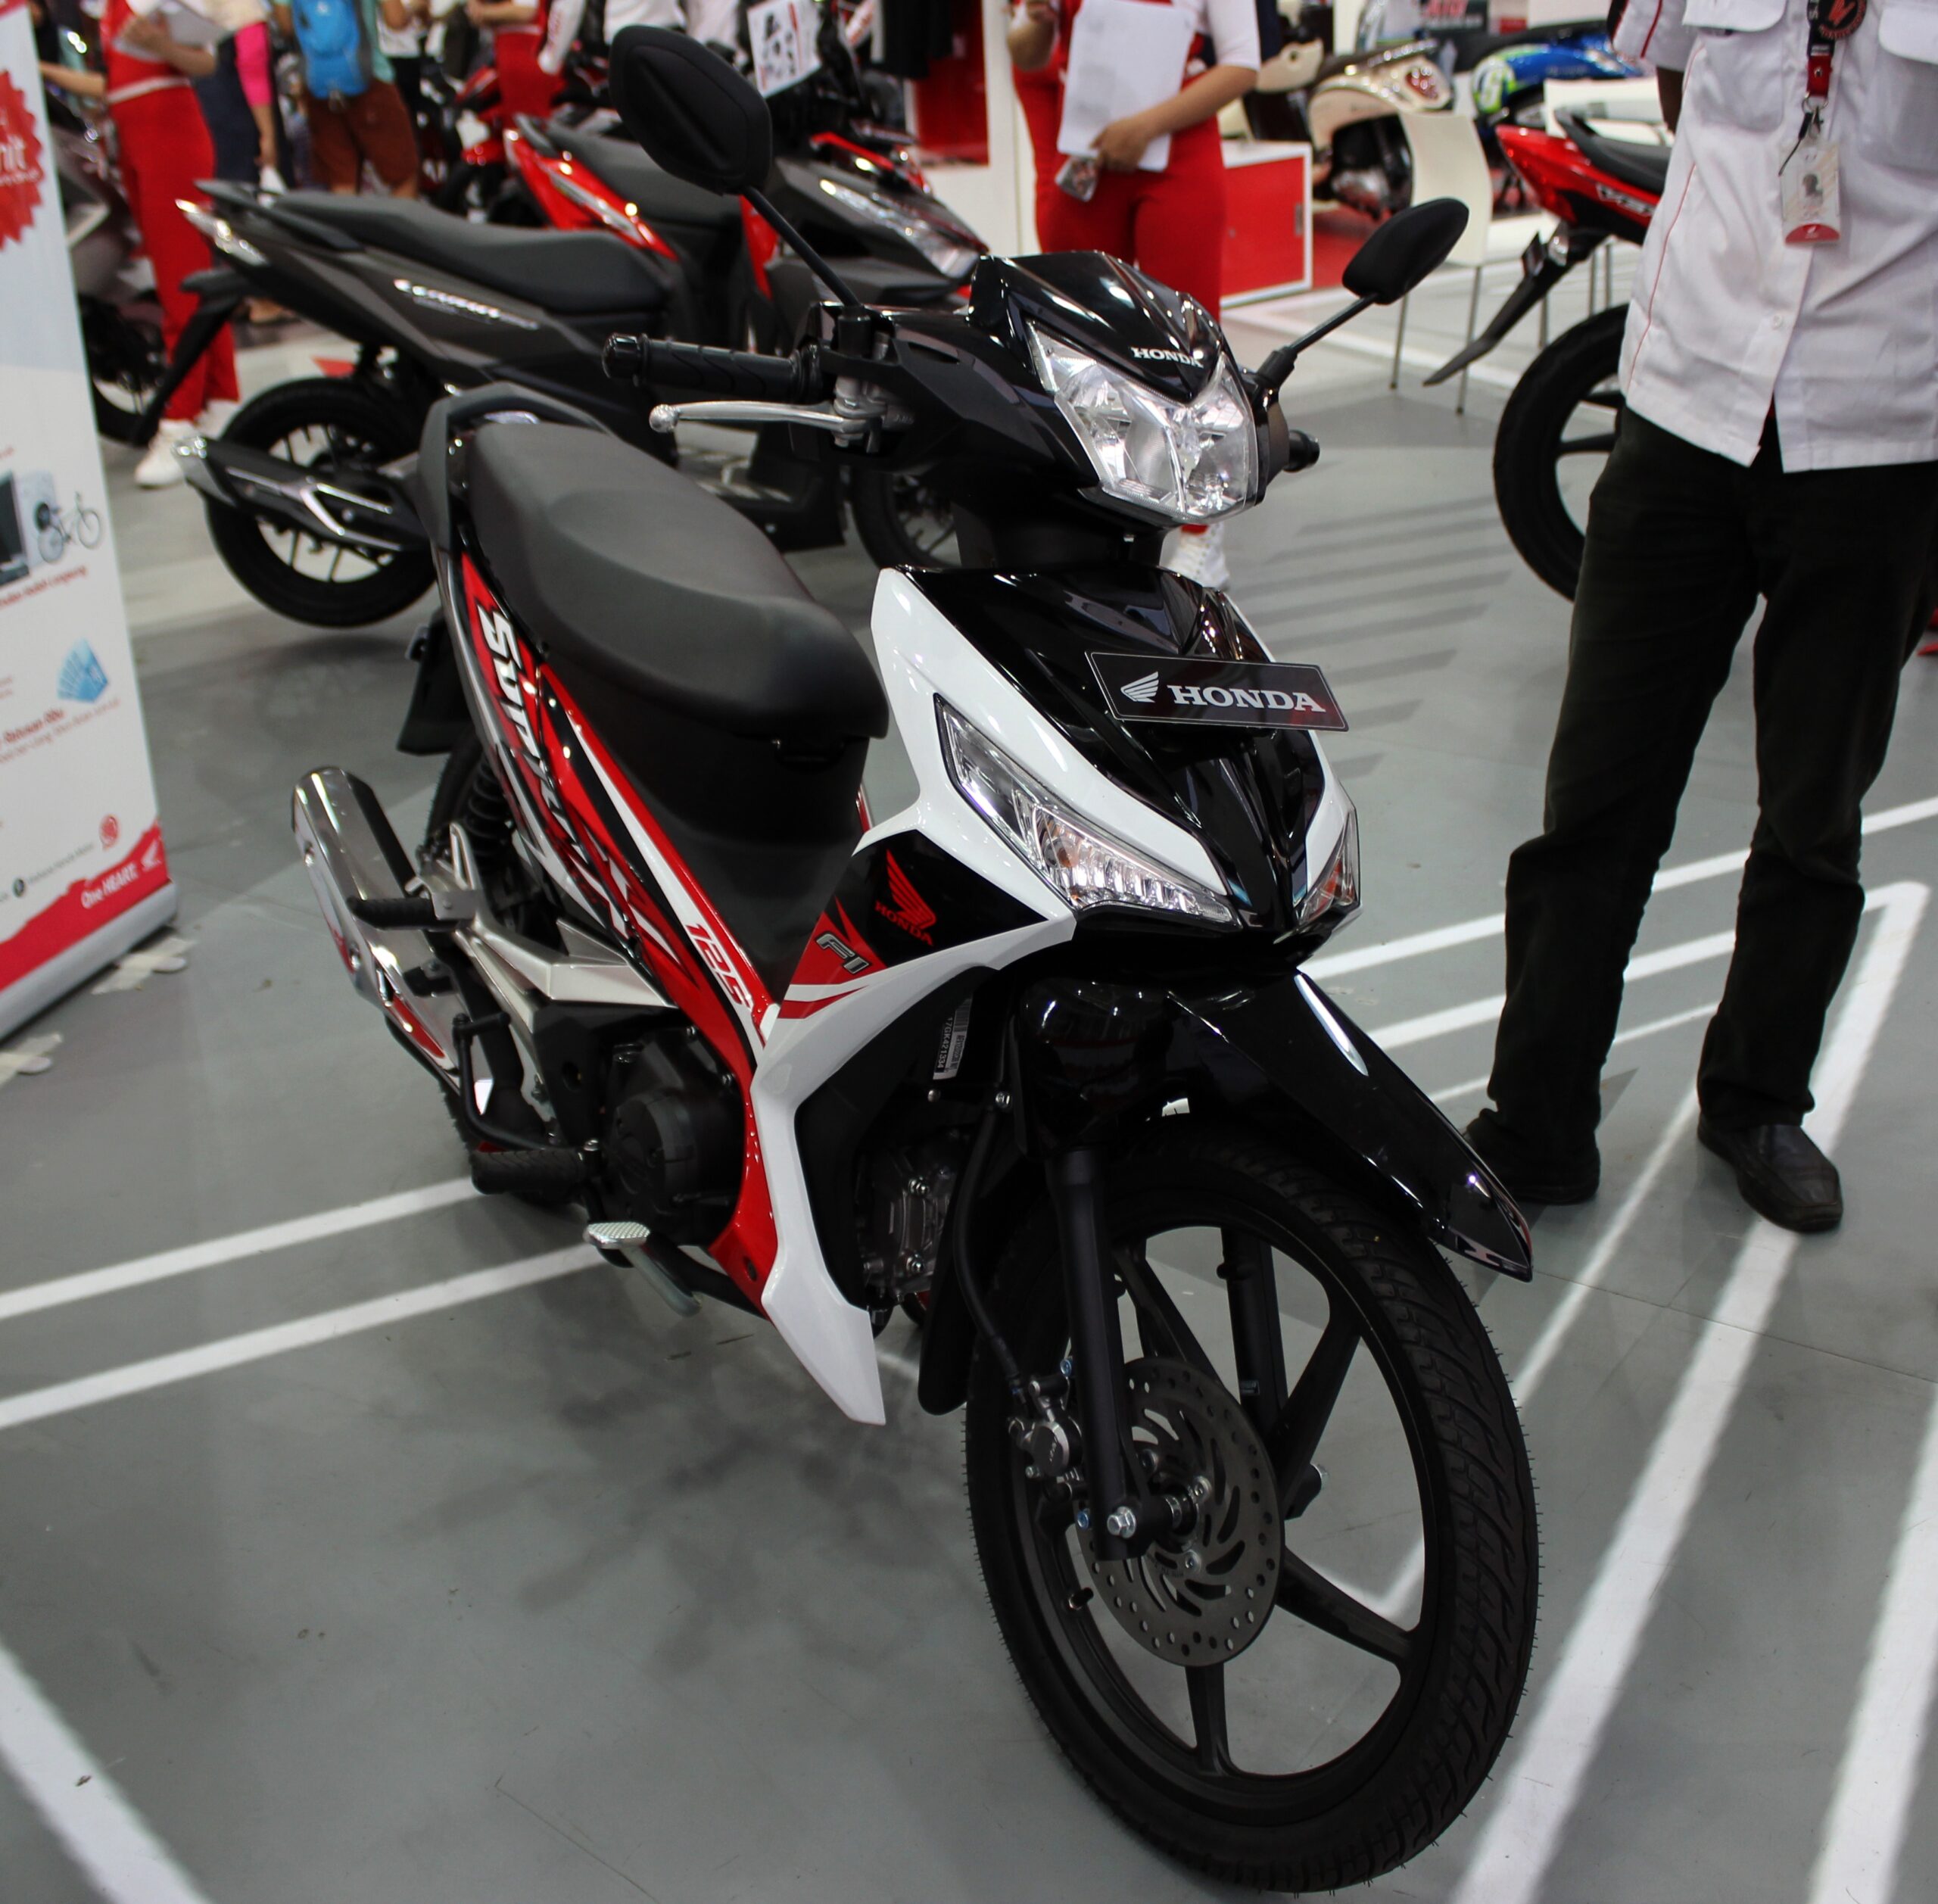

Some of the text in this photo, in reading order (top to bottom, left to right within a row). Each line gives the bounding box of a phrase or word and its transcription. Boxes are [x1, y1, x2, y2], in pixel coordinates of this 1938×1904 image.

[1130, 347, 1204, 369] HONDA
[1167, 684, 1326, 712] HONDA
[875, 900, 932, 946] HONDA
[685, 924, 751, 1008] 125
[816, 933, 870, 974] FI
